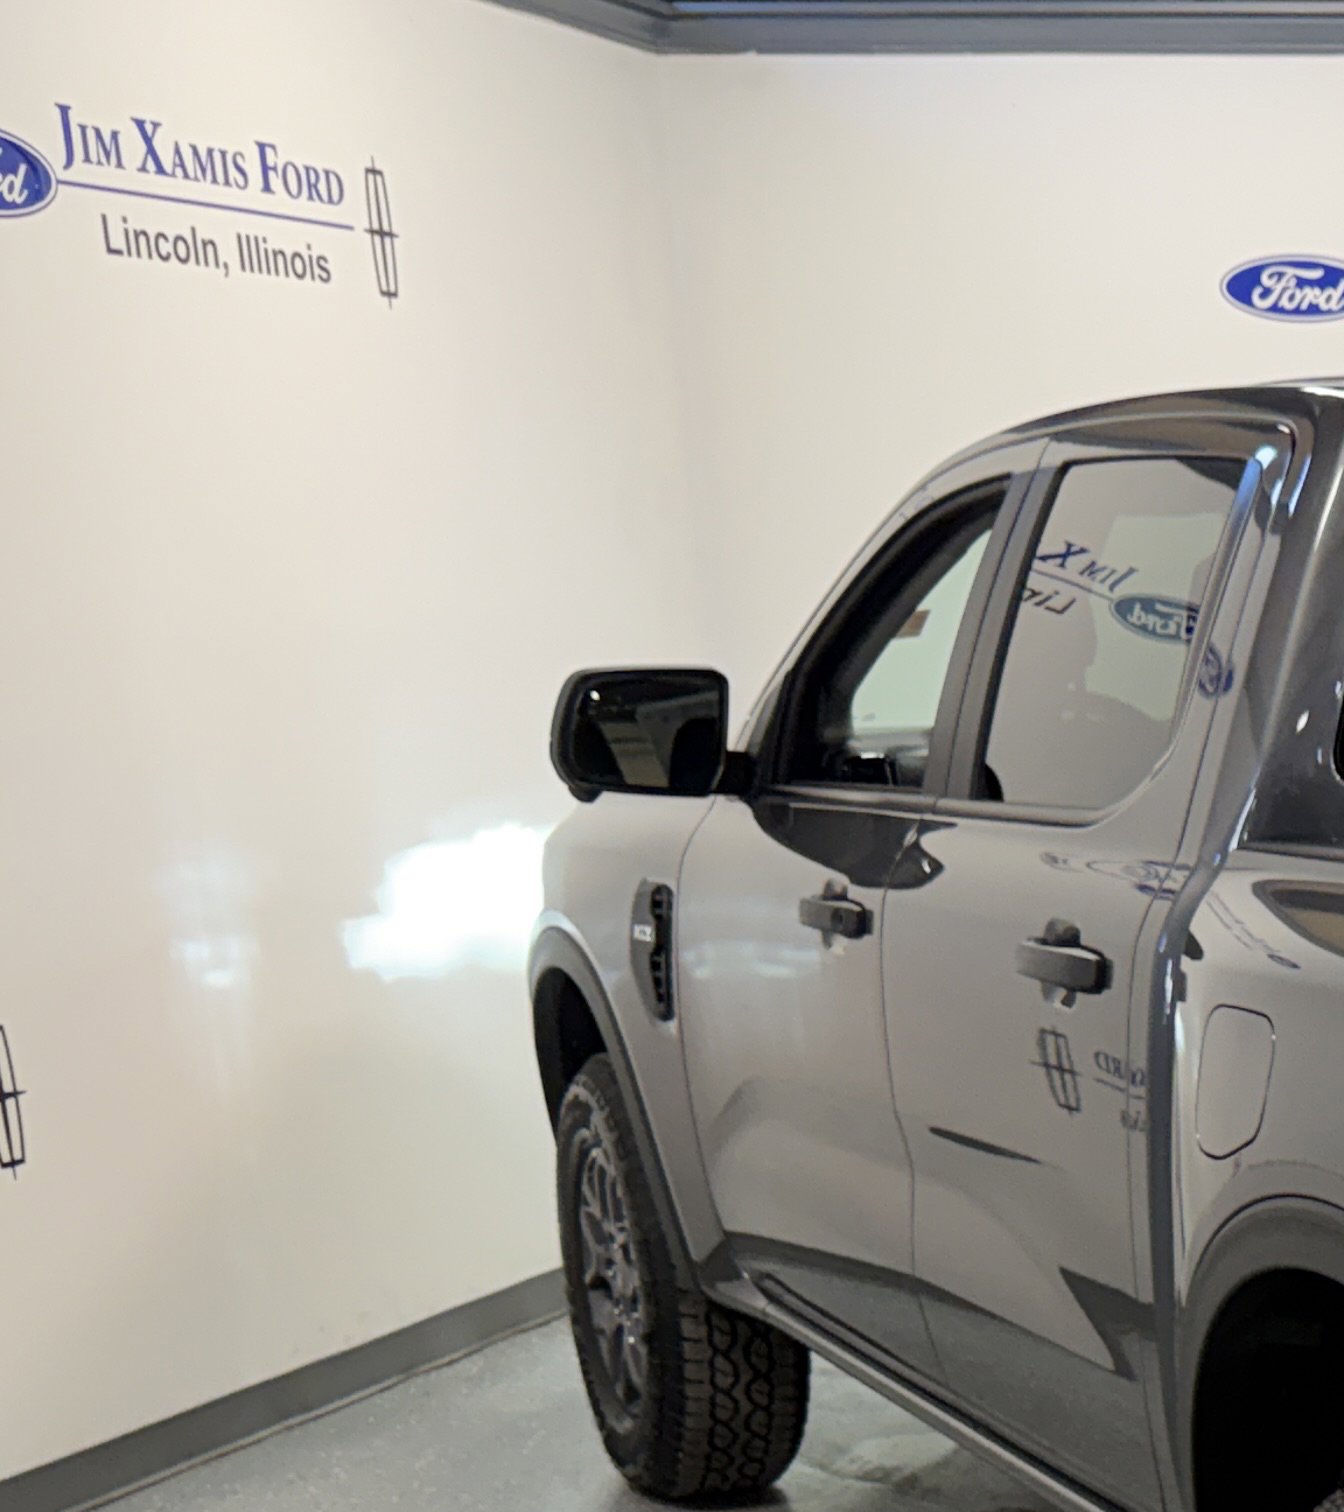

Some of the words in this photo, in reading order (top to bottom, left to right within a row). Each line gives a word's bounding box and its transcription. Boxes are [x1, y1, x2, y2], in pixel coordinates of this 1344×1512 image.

[54, 102, 126, 172] JIM
[131, 116, 249, 190] XAMIS
[254, 140, 344, 206] FORD
[101, 213, 229, 277] Lincoln,
[237, 232, 332, 283] Illinois
